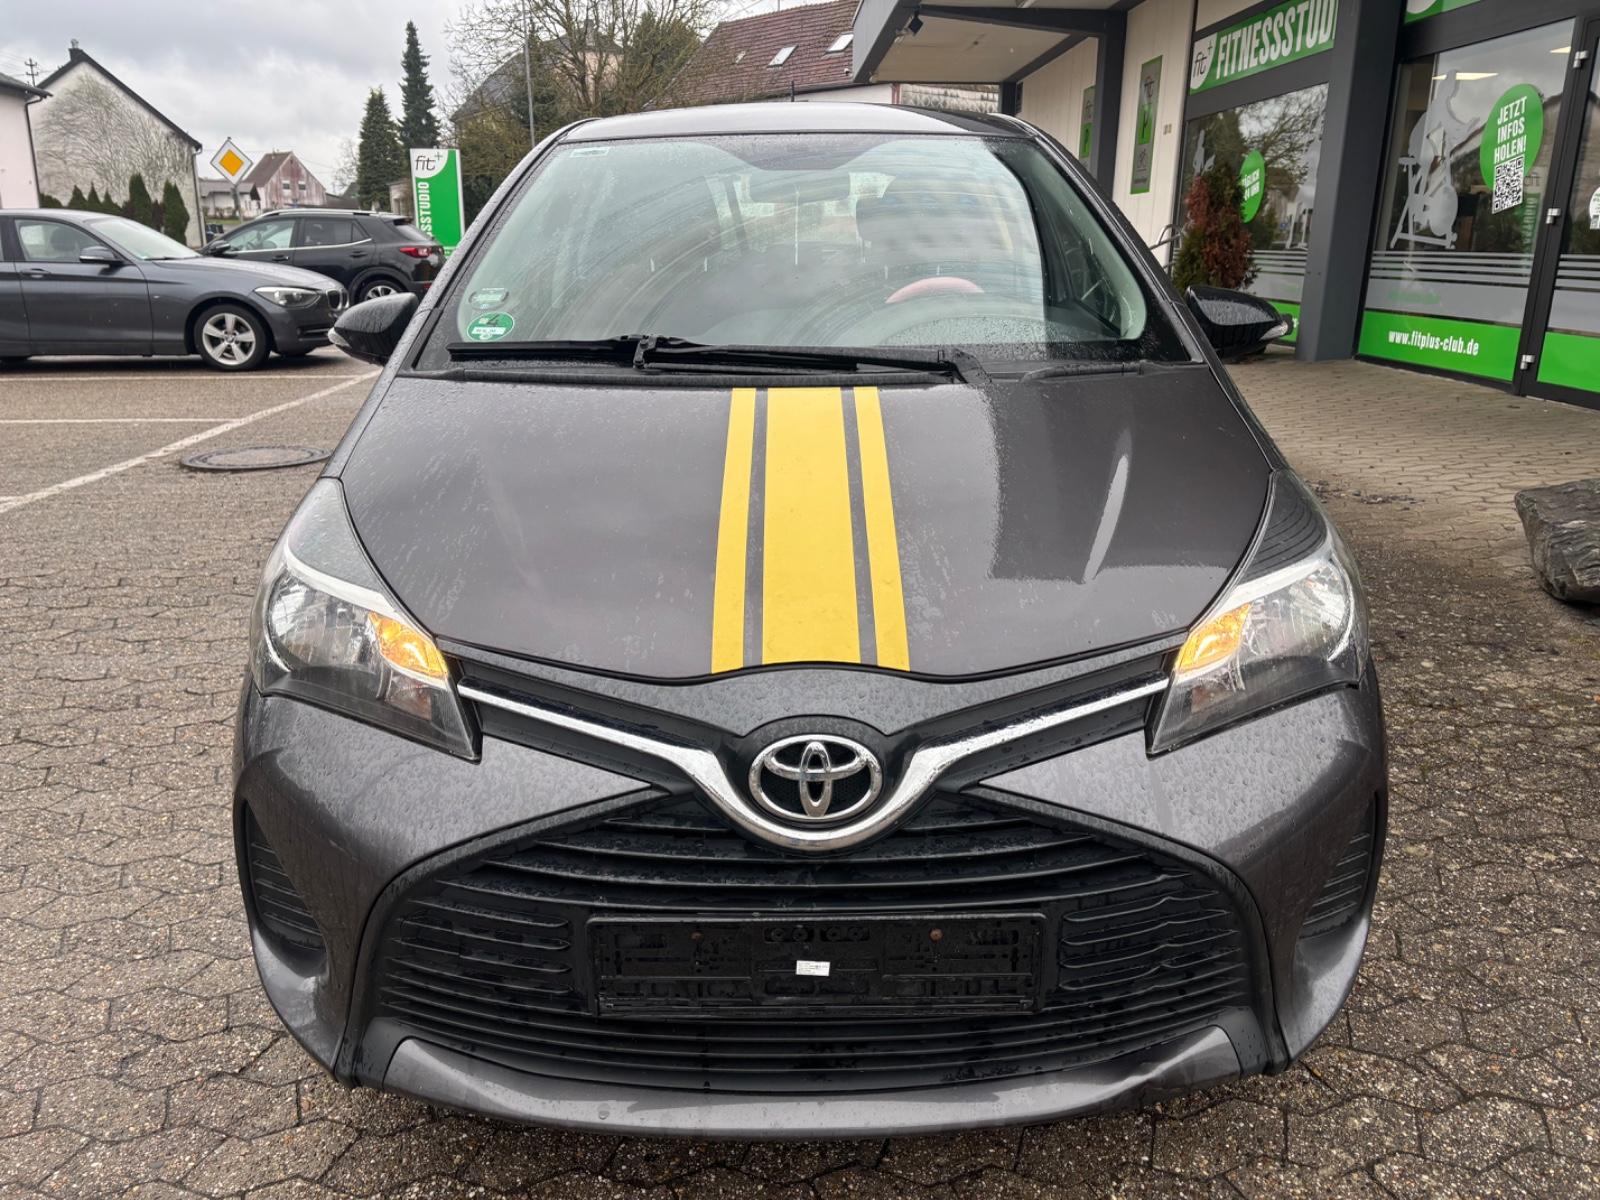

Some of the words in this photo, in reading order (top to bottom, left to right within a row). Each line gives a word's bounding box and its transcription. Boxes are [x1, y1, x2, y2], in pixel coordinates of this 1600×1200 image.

[1497, 97, 1527, 125] JETZT
[1498, 116, 1525, 144] INFOS
[1494, 135, 1527, 164] HOLEN!
[1388, 330, 1479, 356] www.fitplus-club.de
